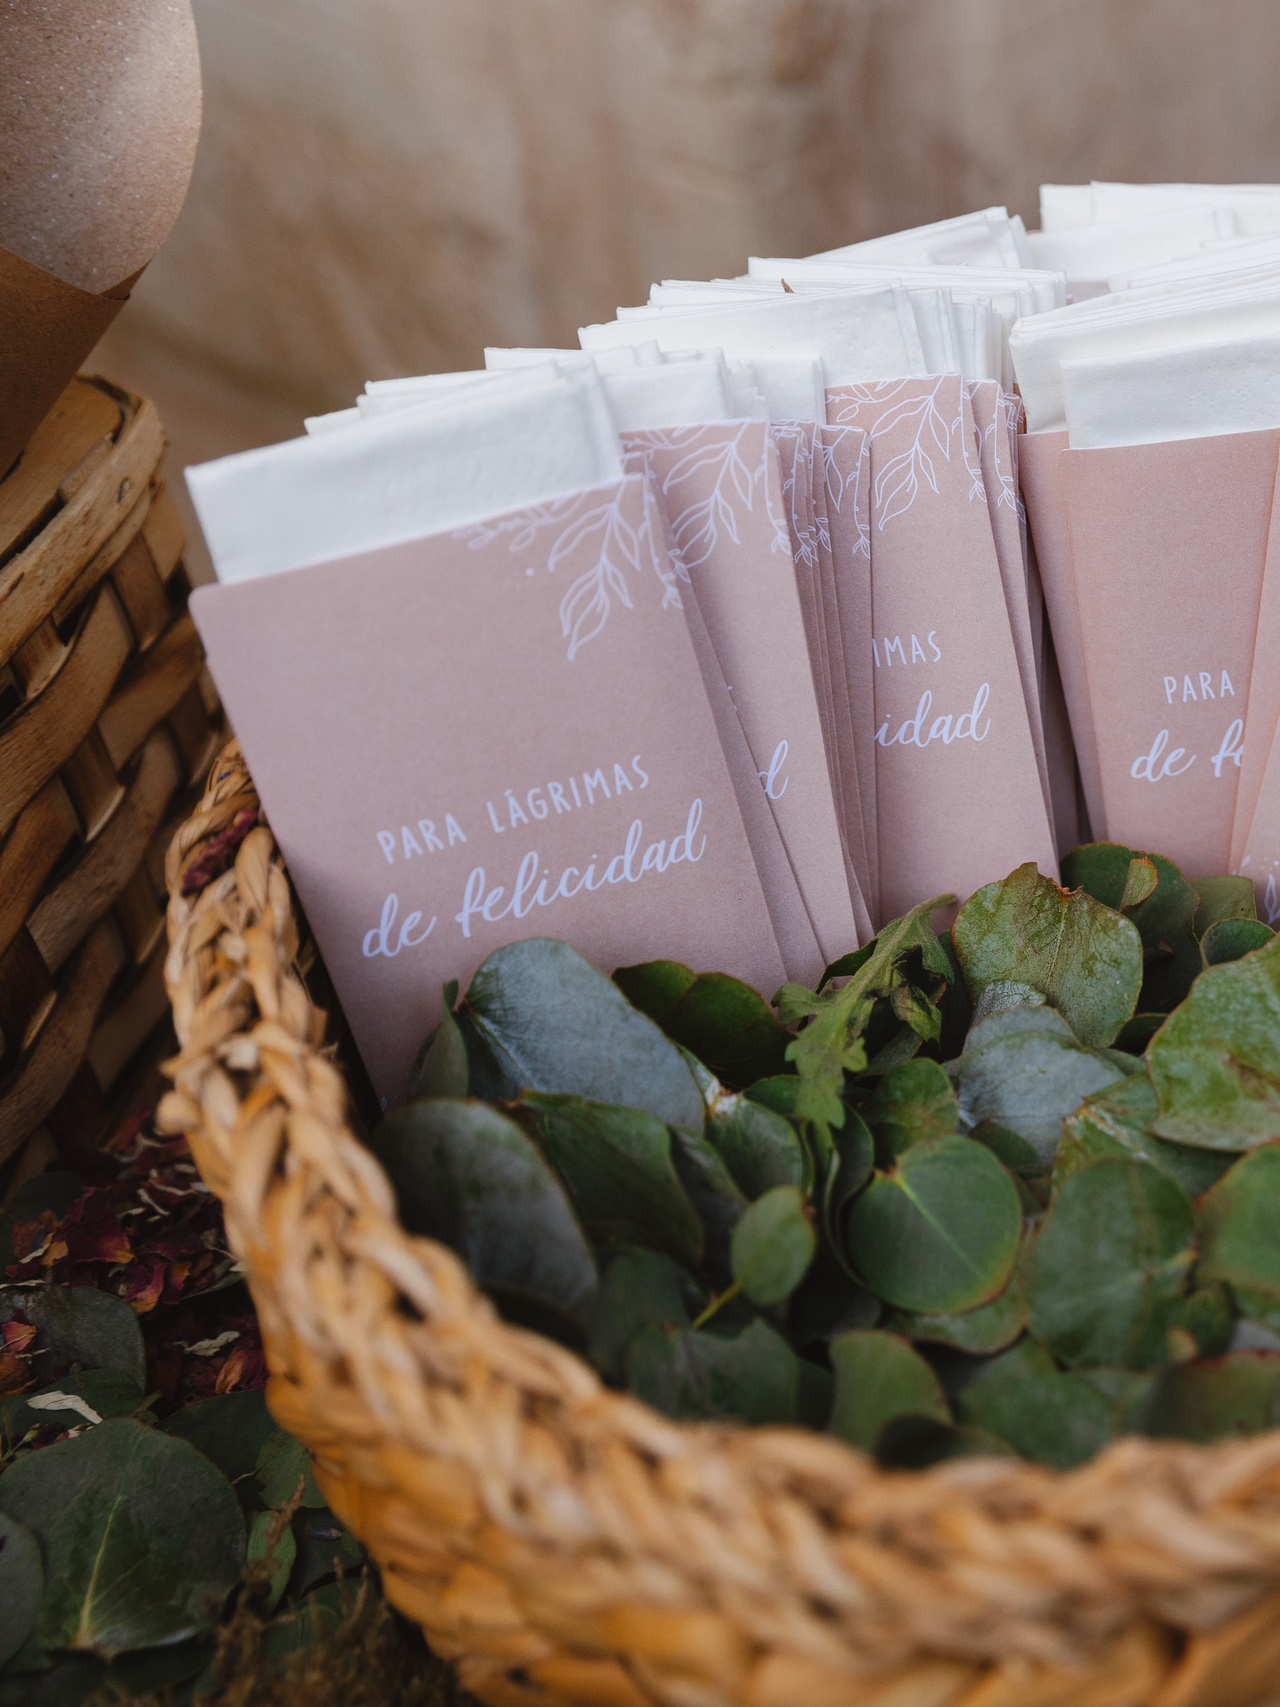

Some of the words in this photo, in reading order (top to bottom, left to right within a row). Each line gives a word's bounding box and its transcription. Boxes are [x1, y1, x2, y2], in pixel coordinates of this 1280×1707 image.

[1163, 669, 1235, 704] PARA
[1130, 729, 1196, 783] de
[376, 813, 468, 864] PARA
[486, 754, 650, 834] LÁGRIMAS
[362, 893, 437, 958] de
[454, 797, 707, 938] felicidad
